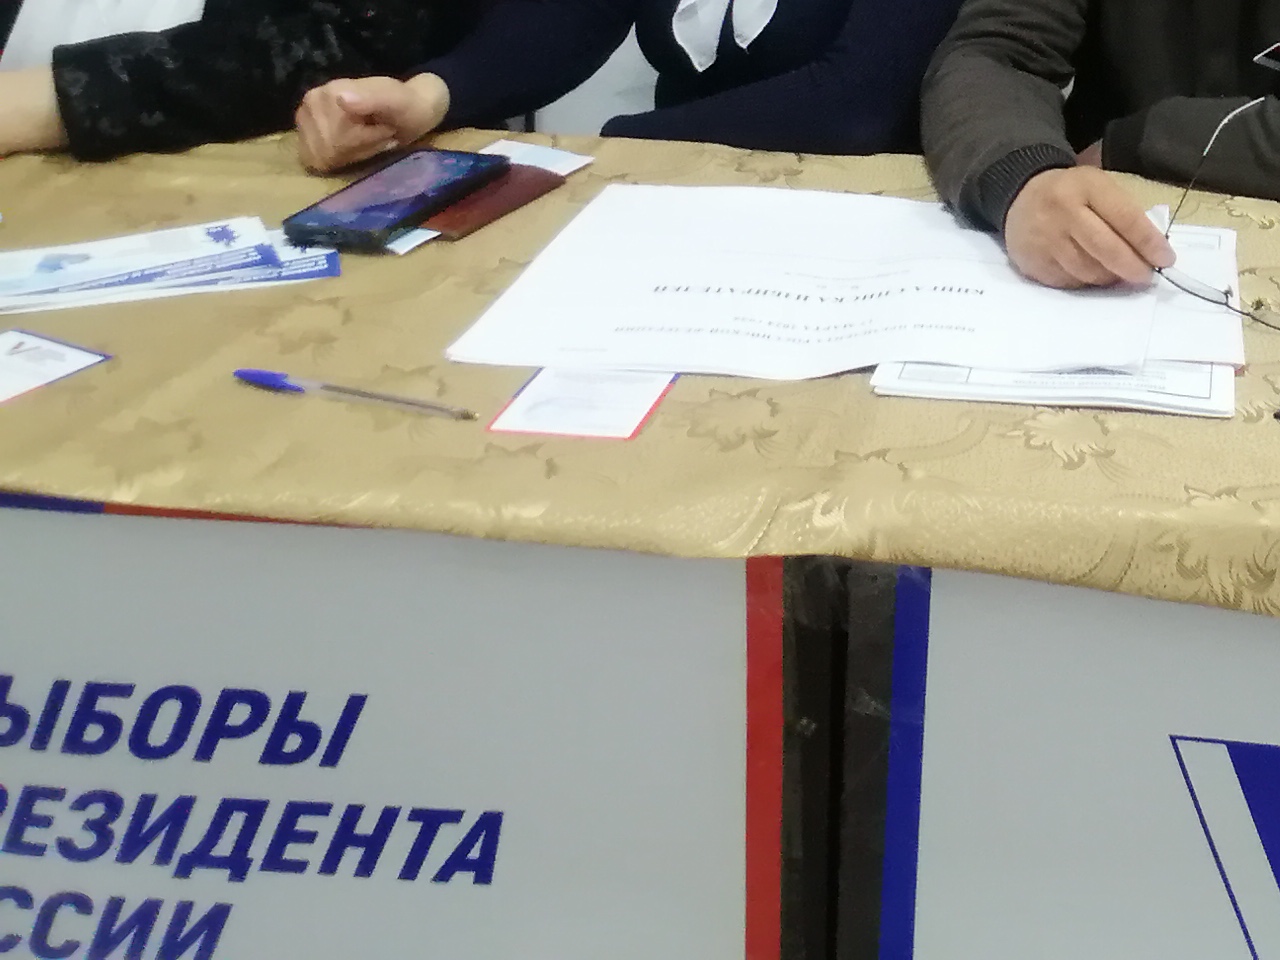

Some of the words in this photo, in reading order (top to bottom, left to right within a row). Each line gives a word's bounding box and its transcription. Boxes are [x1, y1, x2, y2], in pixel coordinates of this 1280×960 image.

[0, 675, 368, 767] ЫБОРЫ
[0, 784, 503, 885] ЕЗИДЕНТА
[0, 886, 233, 960] ССИИ
